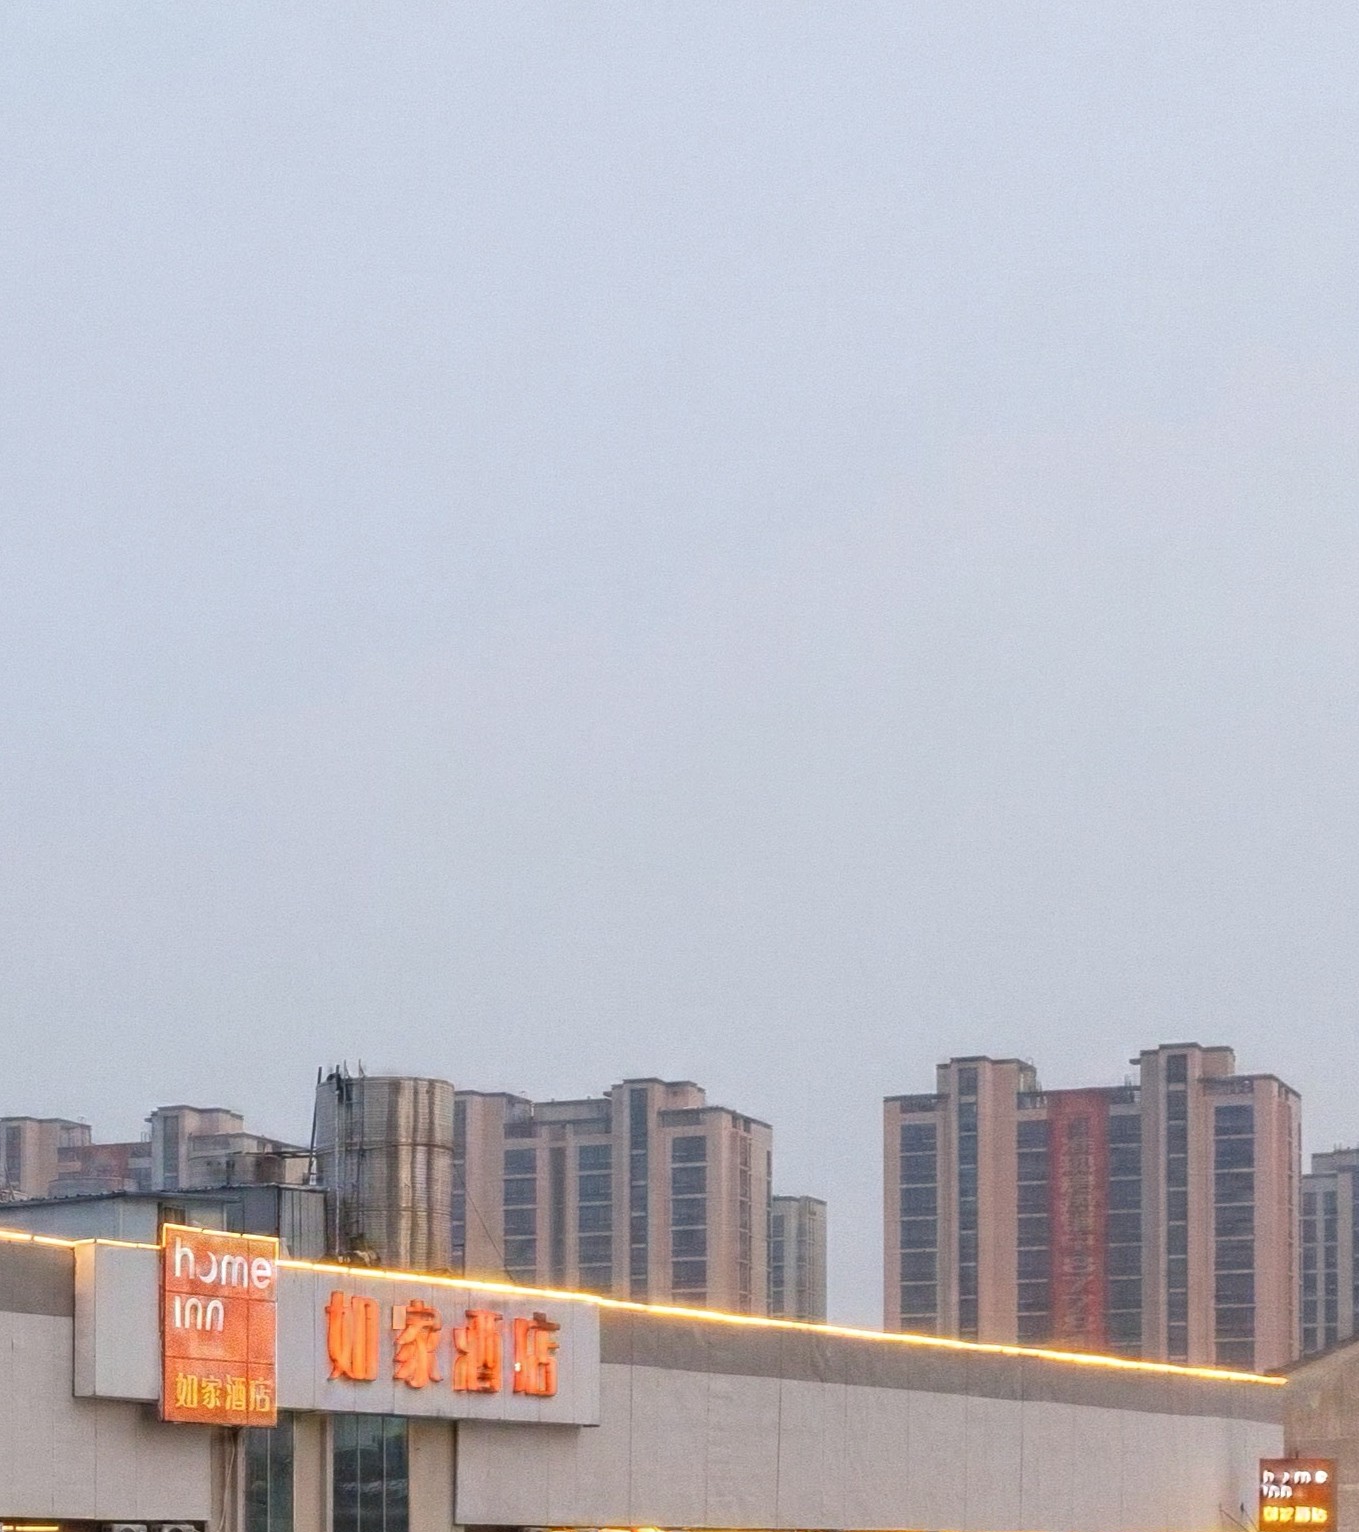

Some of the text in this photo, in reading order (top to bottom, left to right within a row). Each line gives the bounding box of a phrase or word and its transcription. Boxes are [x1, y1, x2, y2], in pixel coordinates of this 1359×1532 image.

[175, 1237, 272, 1289] home
[173, 1295, 225, 1332] inn
[325, 1290, 561, 1397] 如家酒店
[175, 1372, 272, 1412] 如家酒店
